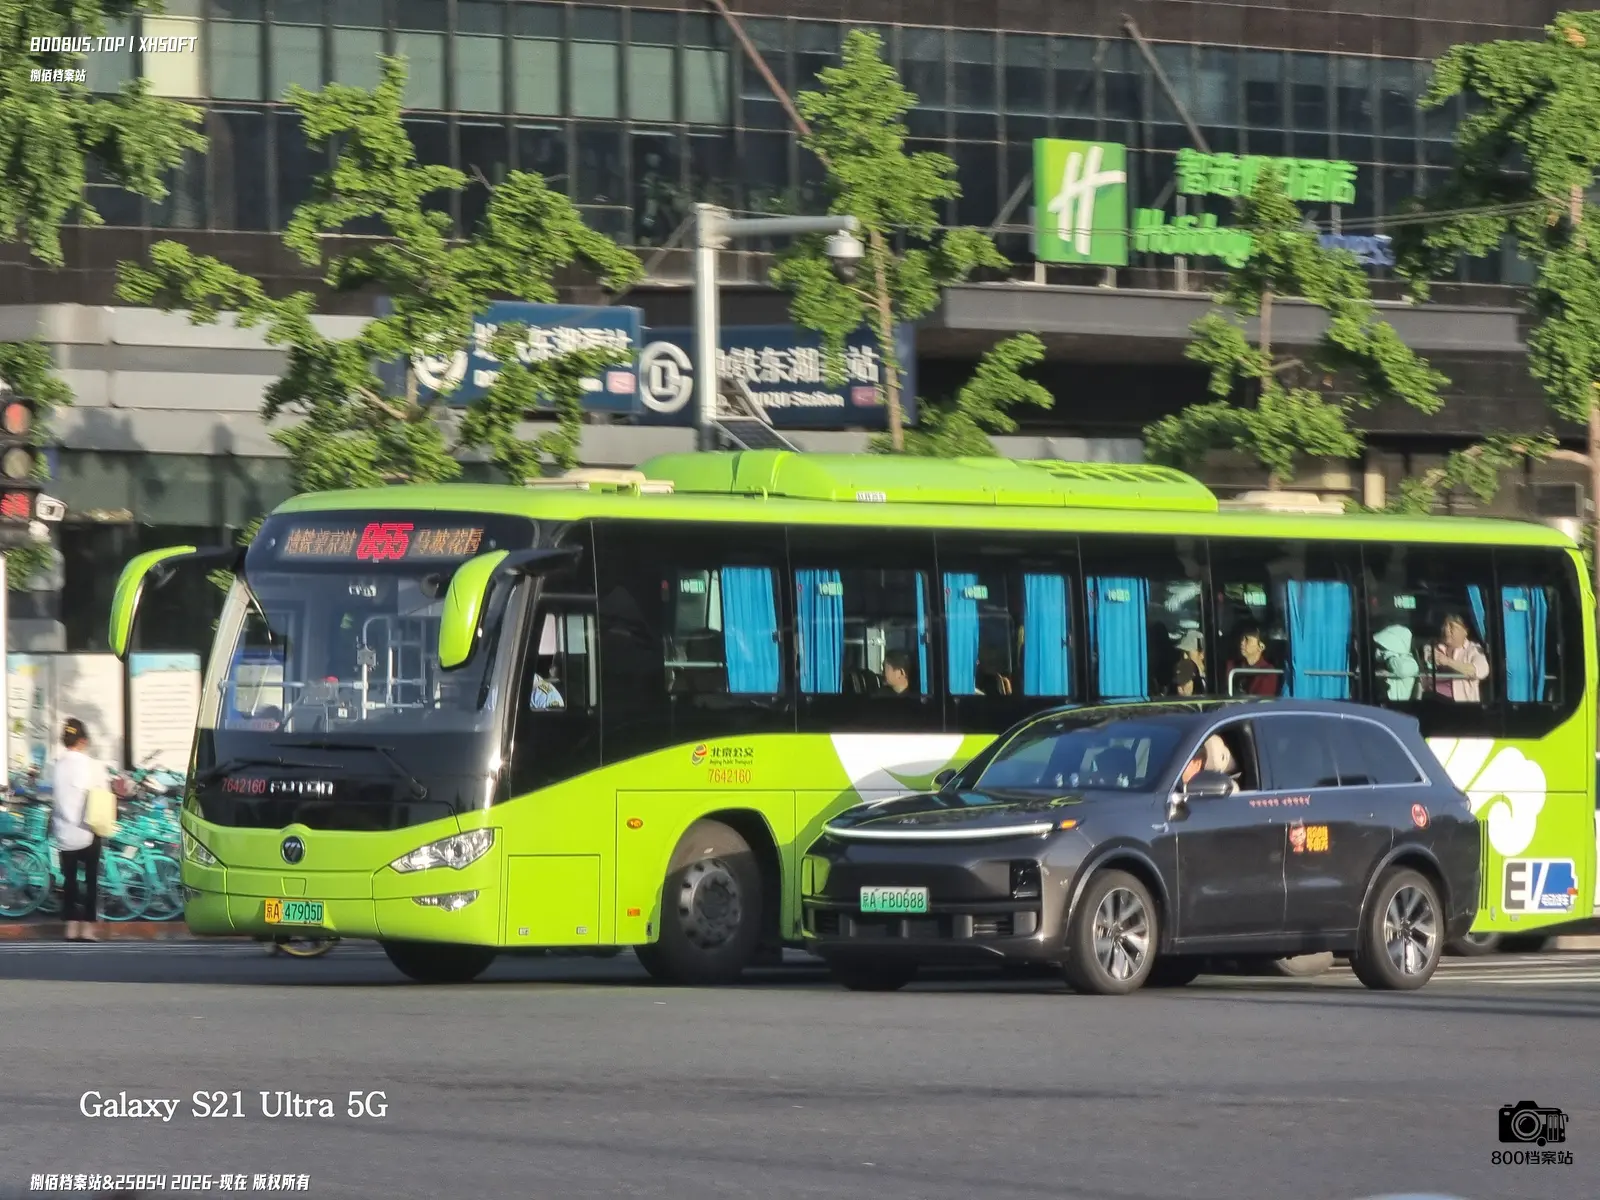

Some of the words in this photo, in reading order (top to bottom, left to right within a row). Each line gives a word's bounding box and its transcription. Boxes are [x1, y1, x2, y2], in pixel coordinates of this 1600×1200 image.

[716, 345, 881, 384] 地铁东湖站
[711, 747, 754, 758] 北京公交
[709, 769, 752, 783] 7642160
[222, 779, 266, 794] 7642160
